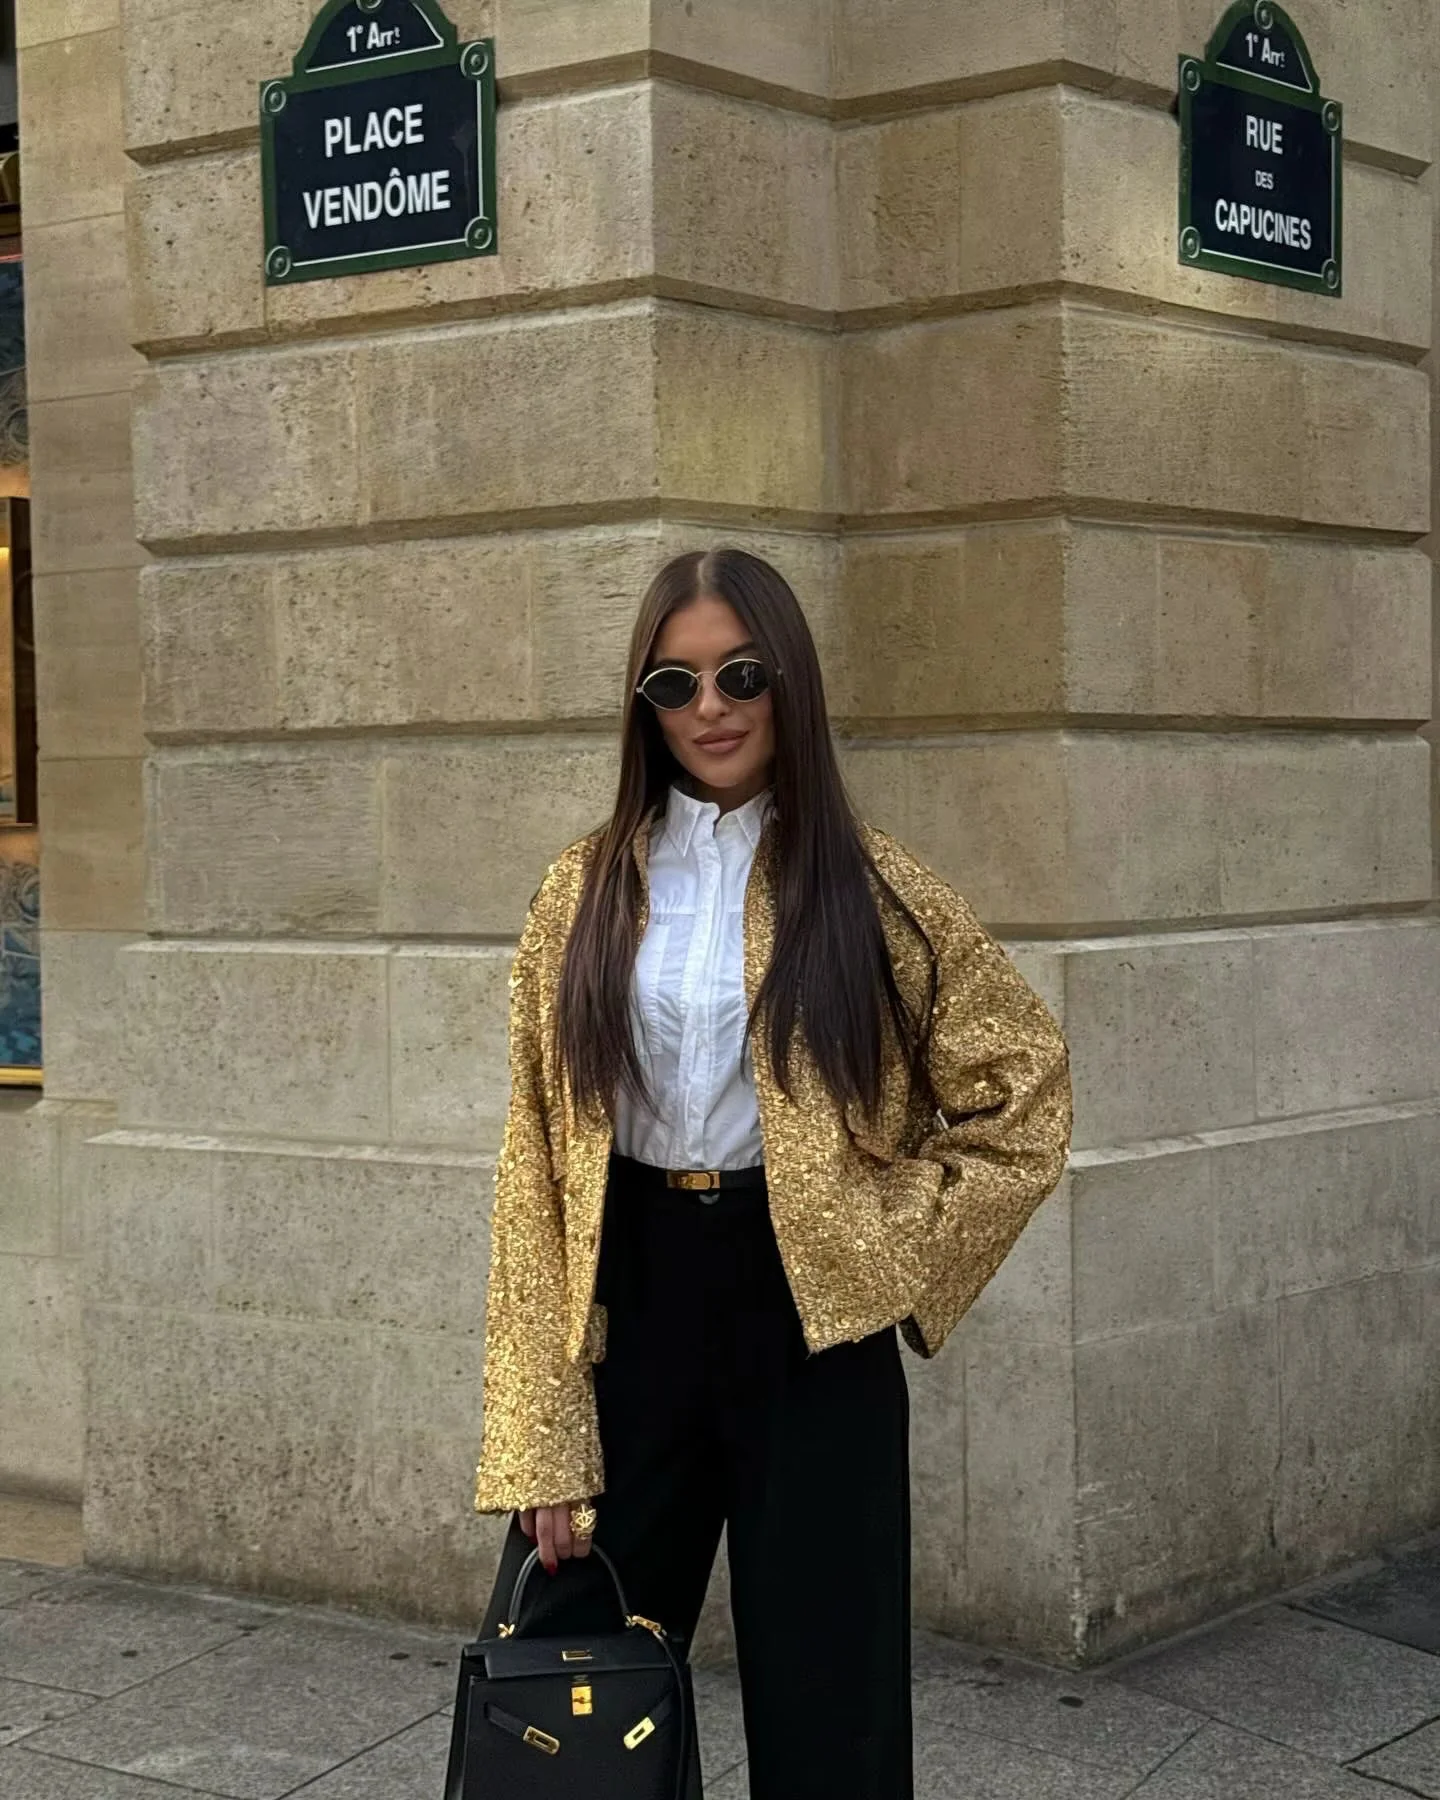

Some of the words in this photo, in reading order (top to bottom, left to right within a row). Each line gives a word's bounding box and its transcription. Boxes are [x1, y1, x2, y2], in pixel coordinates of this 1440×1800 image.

[325, 104, 424, 157] PLACE
[1246, 115, 1283, 154] RUE
[303, 168, 450, 228] VENDÔME
[1255, 170, 1273, 189] DES
[1215, 199, 1311, 250] CAPUCINES
